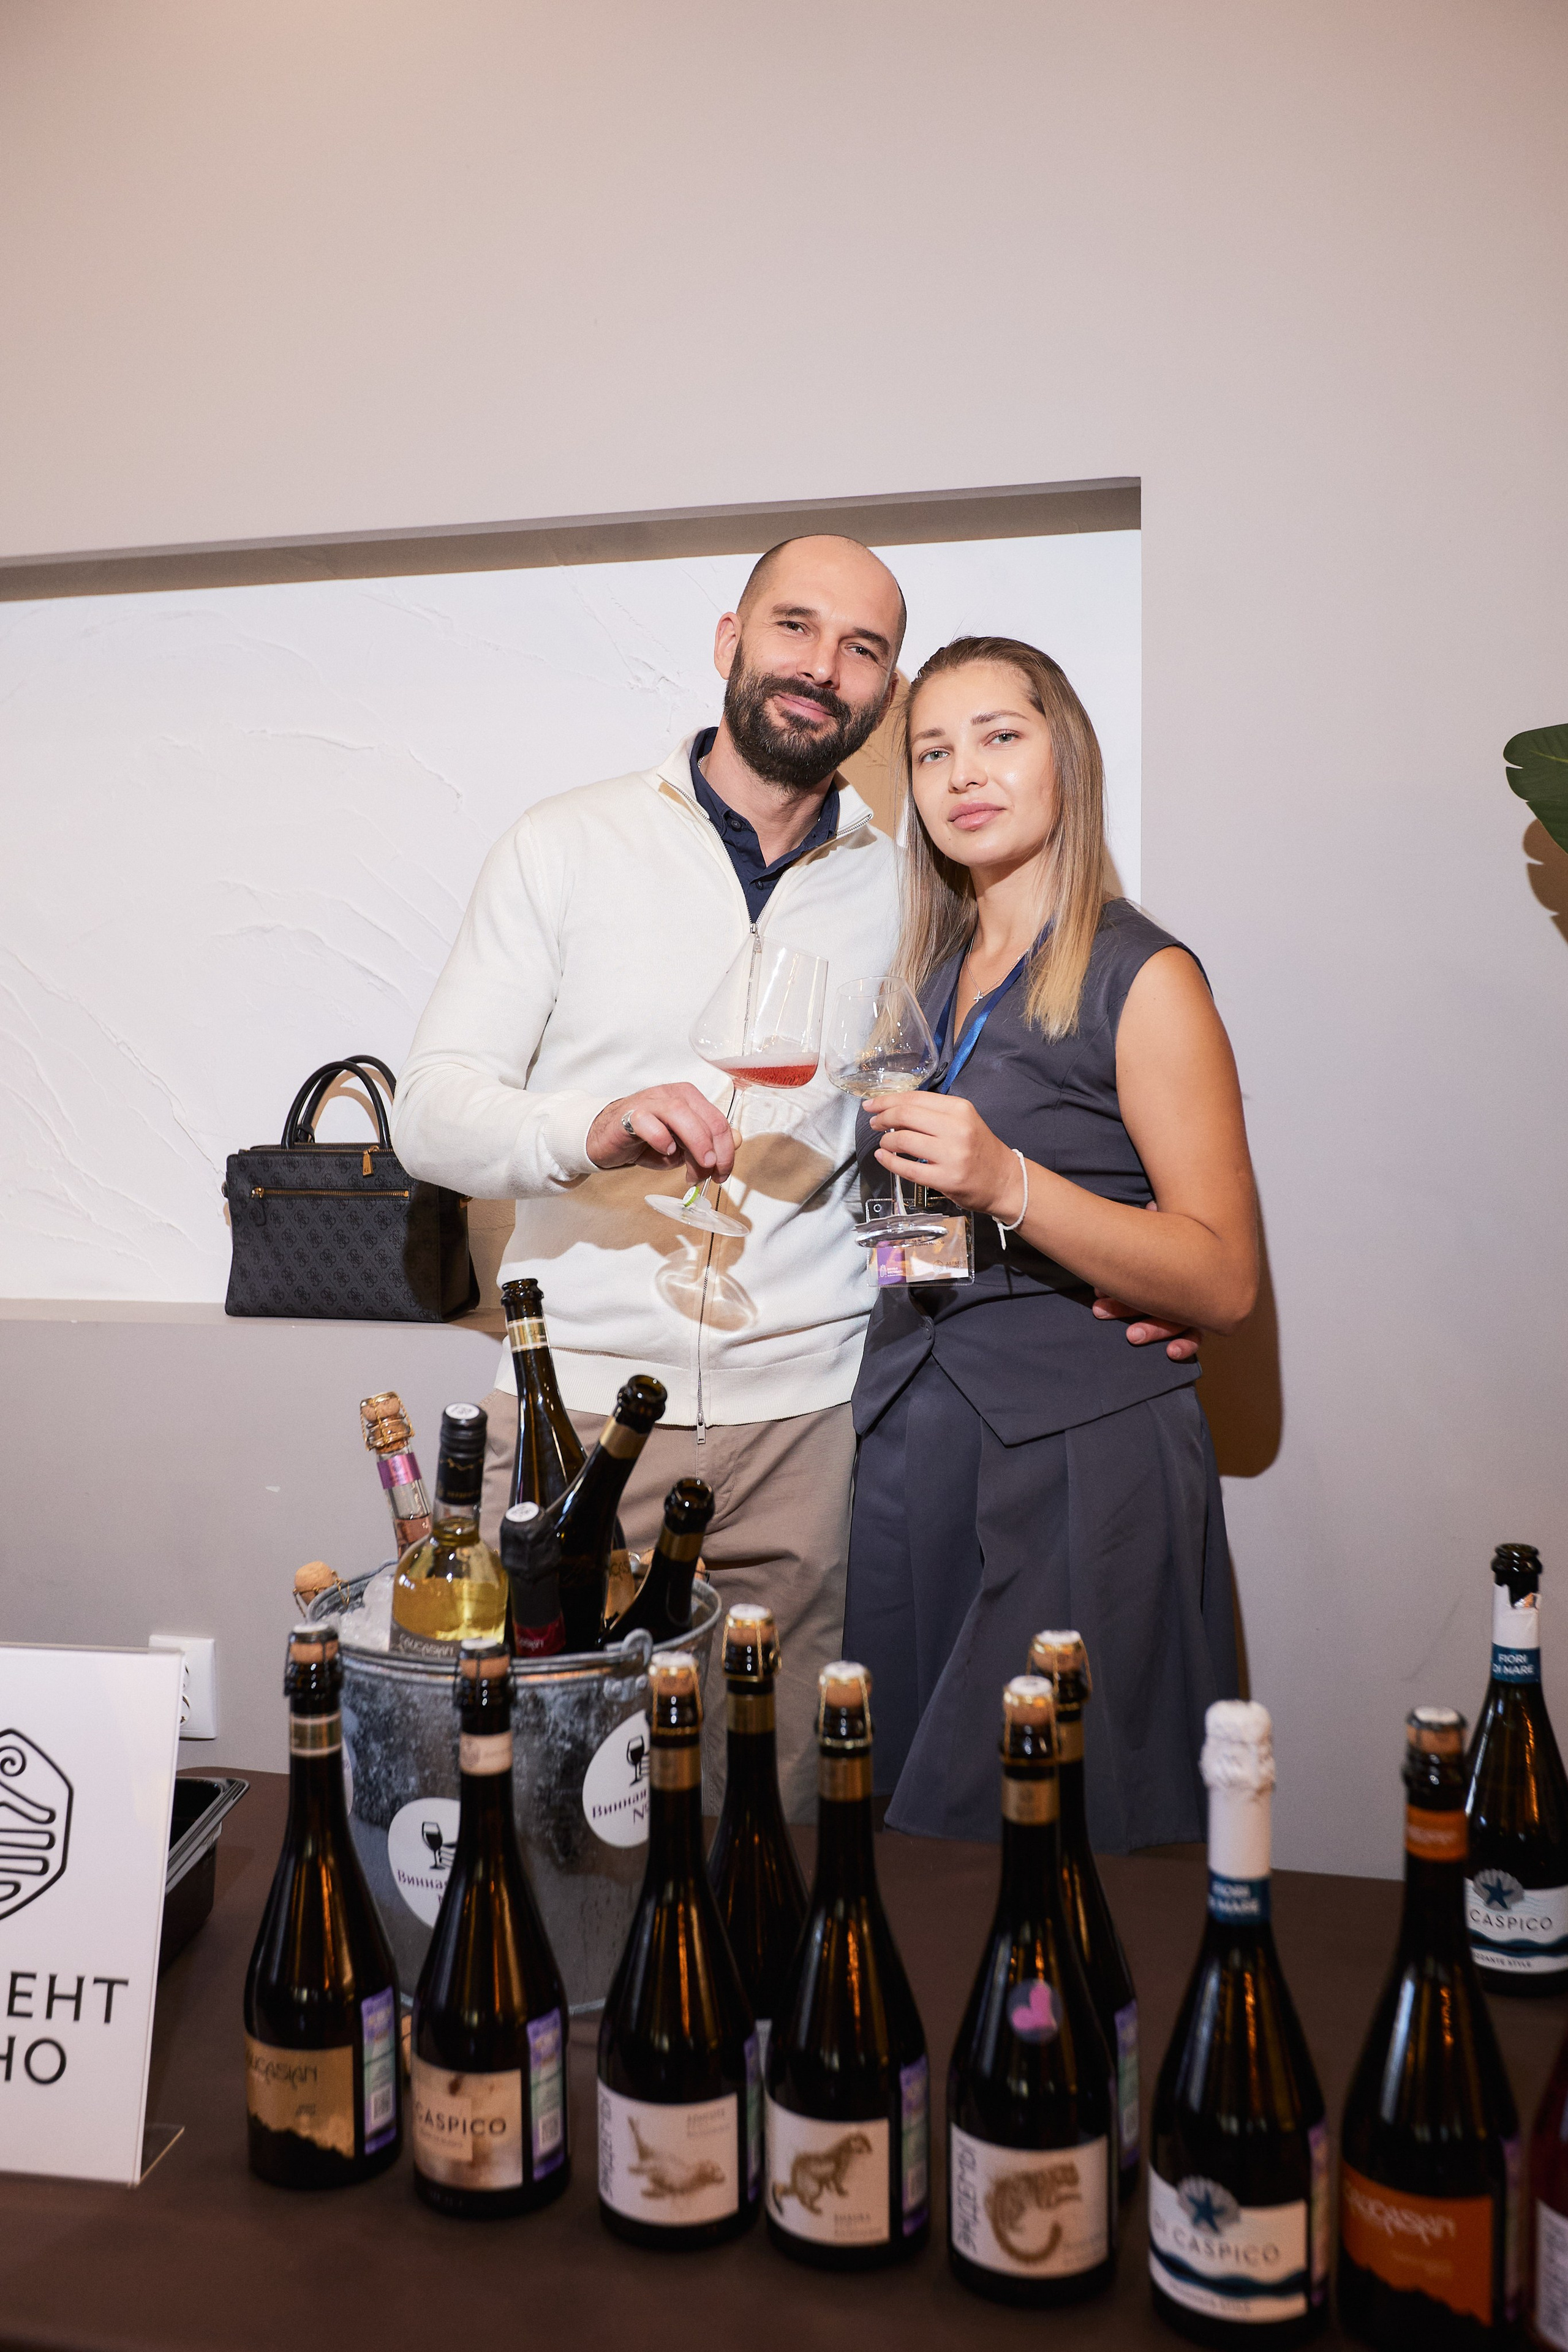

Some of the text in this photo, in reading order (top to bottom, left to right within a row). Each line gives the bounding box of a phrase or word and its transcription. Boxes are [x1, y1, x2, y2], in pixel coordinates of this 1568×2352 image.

[1469, 1908, 1553, 1931] CASPICO
[7, 1970, 129, 2024] ЕНТ
[413, 2101, 507, 2136] CASPICO
[1172, 2225, 1280, 2267] CASPICO
